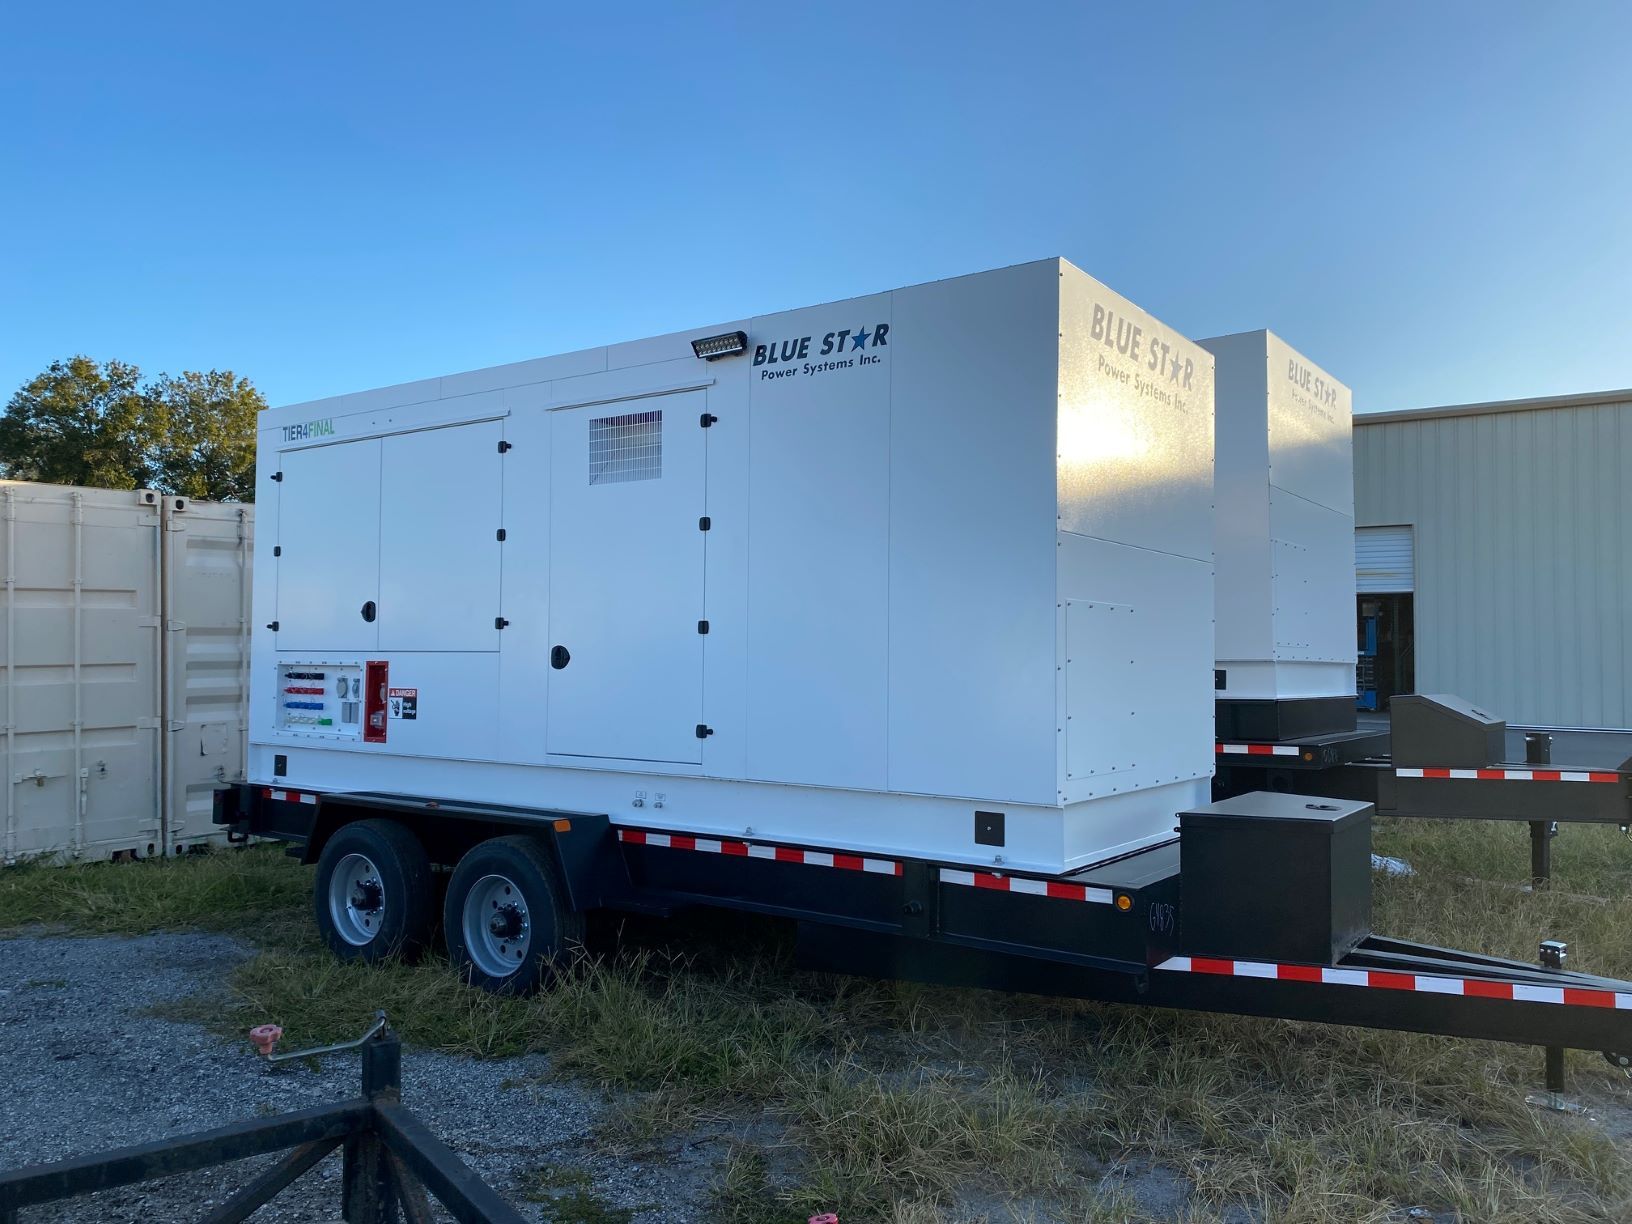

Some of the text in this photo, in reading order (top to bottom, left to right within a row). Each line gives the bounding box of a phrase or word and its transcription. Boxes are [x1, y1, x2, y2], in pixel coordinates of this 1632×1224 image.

[1090, 303, 1142, 362] BLUE
[752, 336, 811, 366] BLUE
[761, 354, 881, 380] Power Systems Inc.
[1098, 353, 1130, 385] Power
[1134, 373, 1171, 406] Systems
[1288, 358, 1311, 392] BLUE
[395, 689, 416, 697] DANGER
